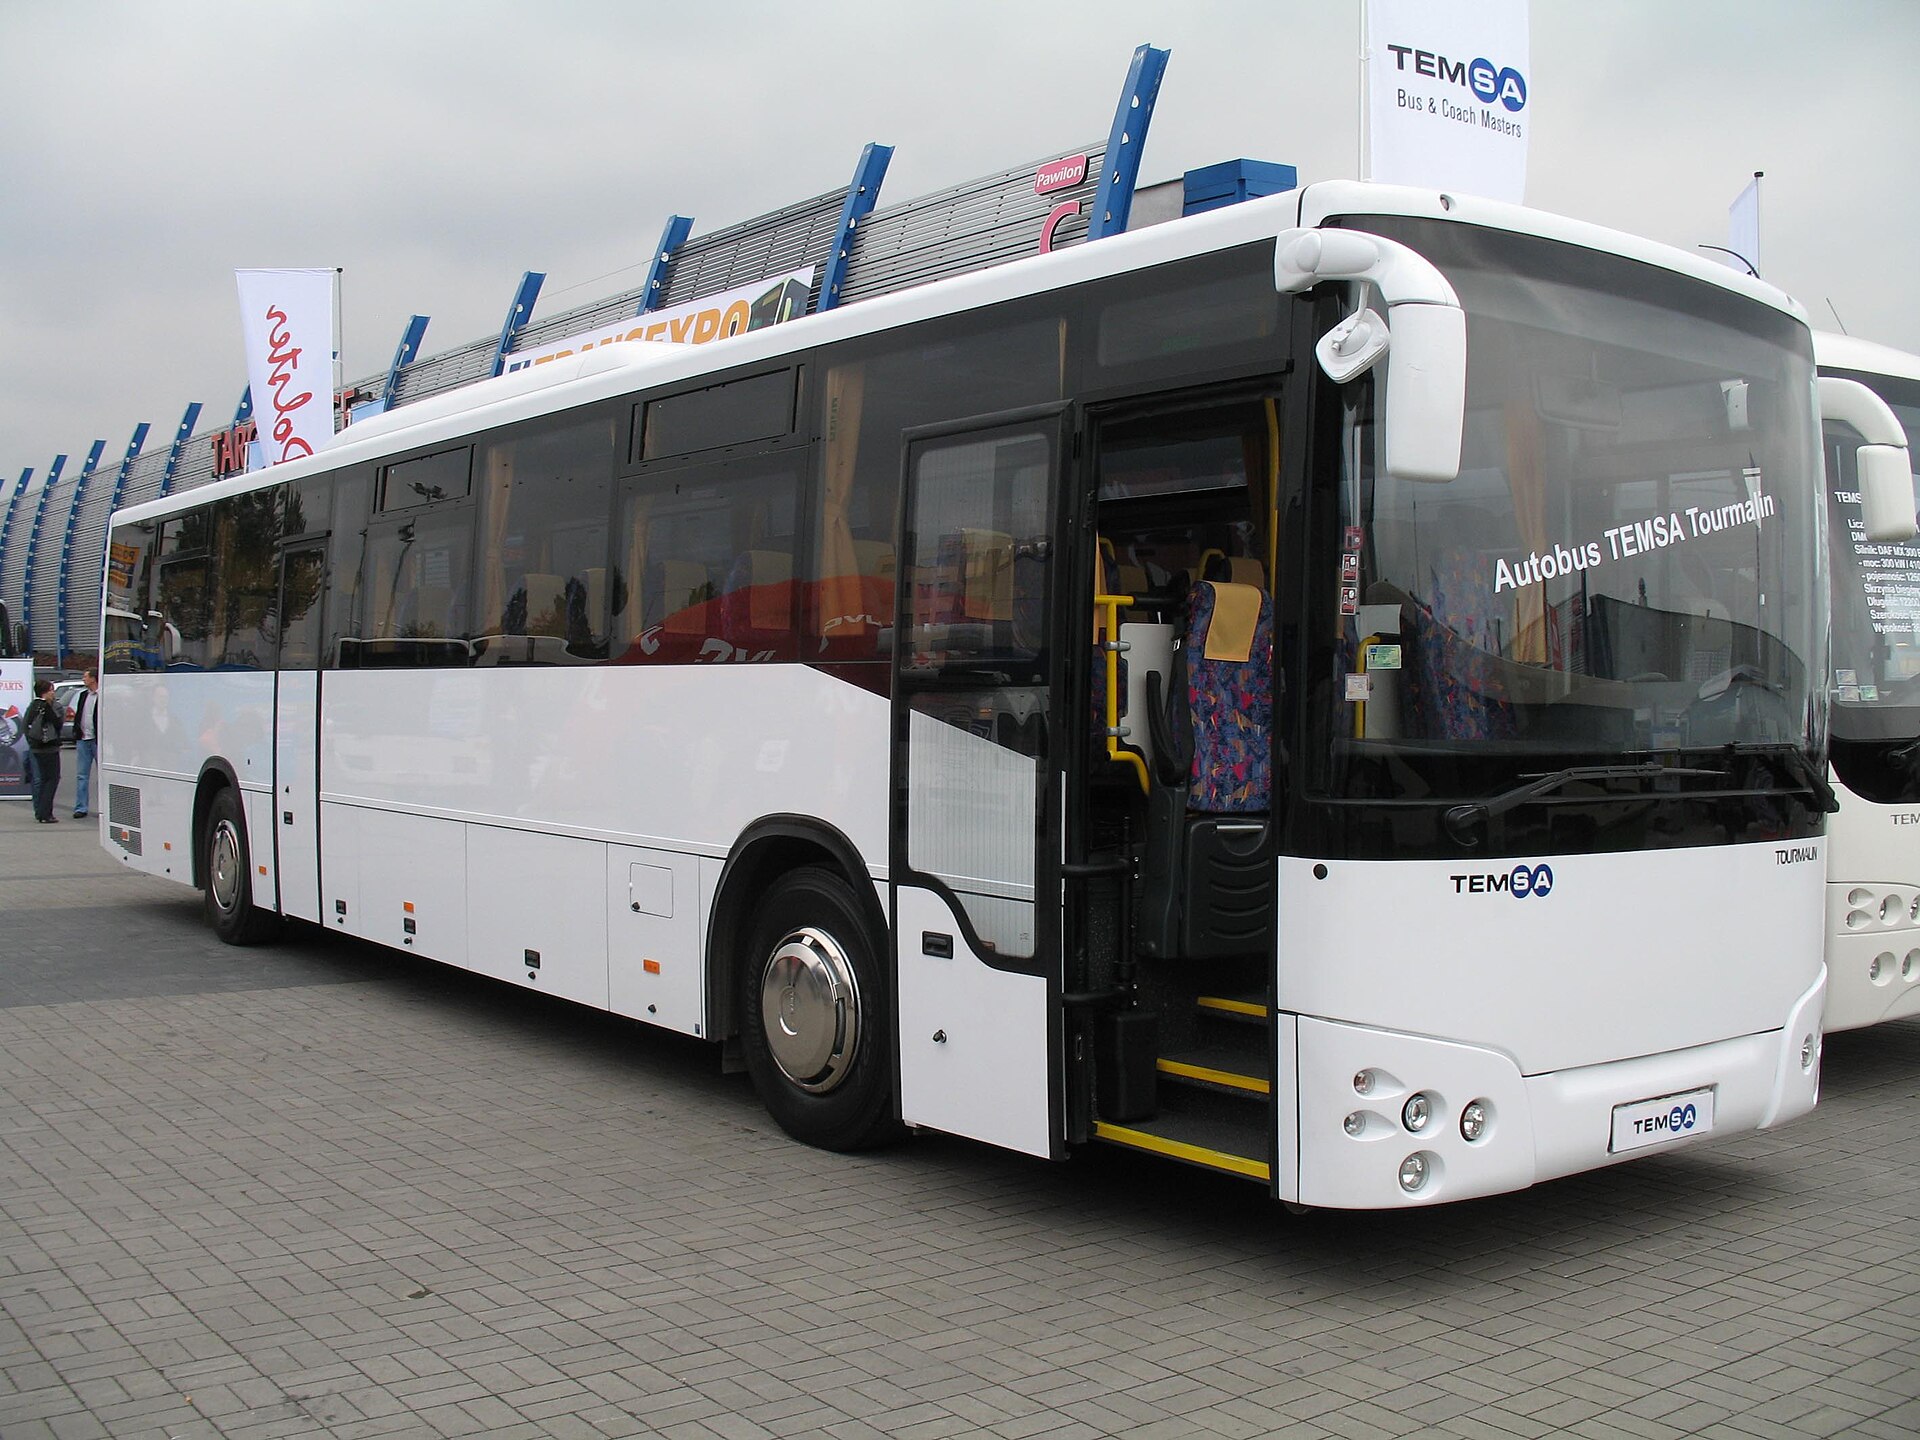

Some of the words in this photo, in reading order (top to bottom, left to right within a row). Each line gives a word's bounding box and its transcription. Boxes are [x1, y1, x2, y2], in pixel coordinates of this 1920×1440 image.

[1387, 44, 1525, 108] TEMSA
[1397, 88, 1422, 111] Bus
[1428, 97, 1437, 114] &
[1442, 98, 1476, 125] Coach
[1481, 109, 1522, 138] Masters
[1036, 165, 1083, 188] Pawilon
[1494, 542, 1601, 594] Autobus
[1603, 512, 1686, 560] TEMSA
[1685, 490, 1776, 538] Tourmalin
[1774, 846, 1818, 865] TOURMALIN
[1450, 865, 1553, 898] TEMSA
[1633, 1105, 1696, 1134] TEMSA
